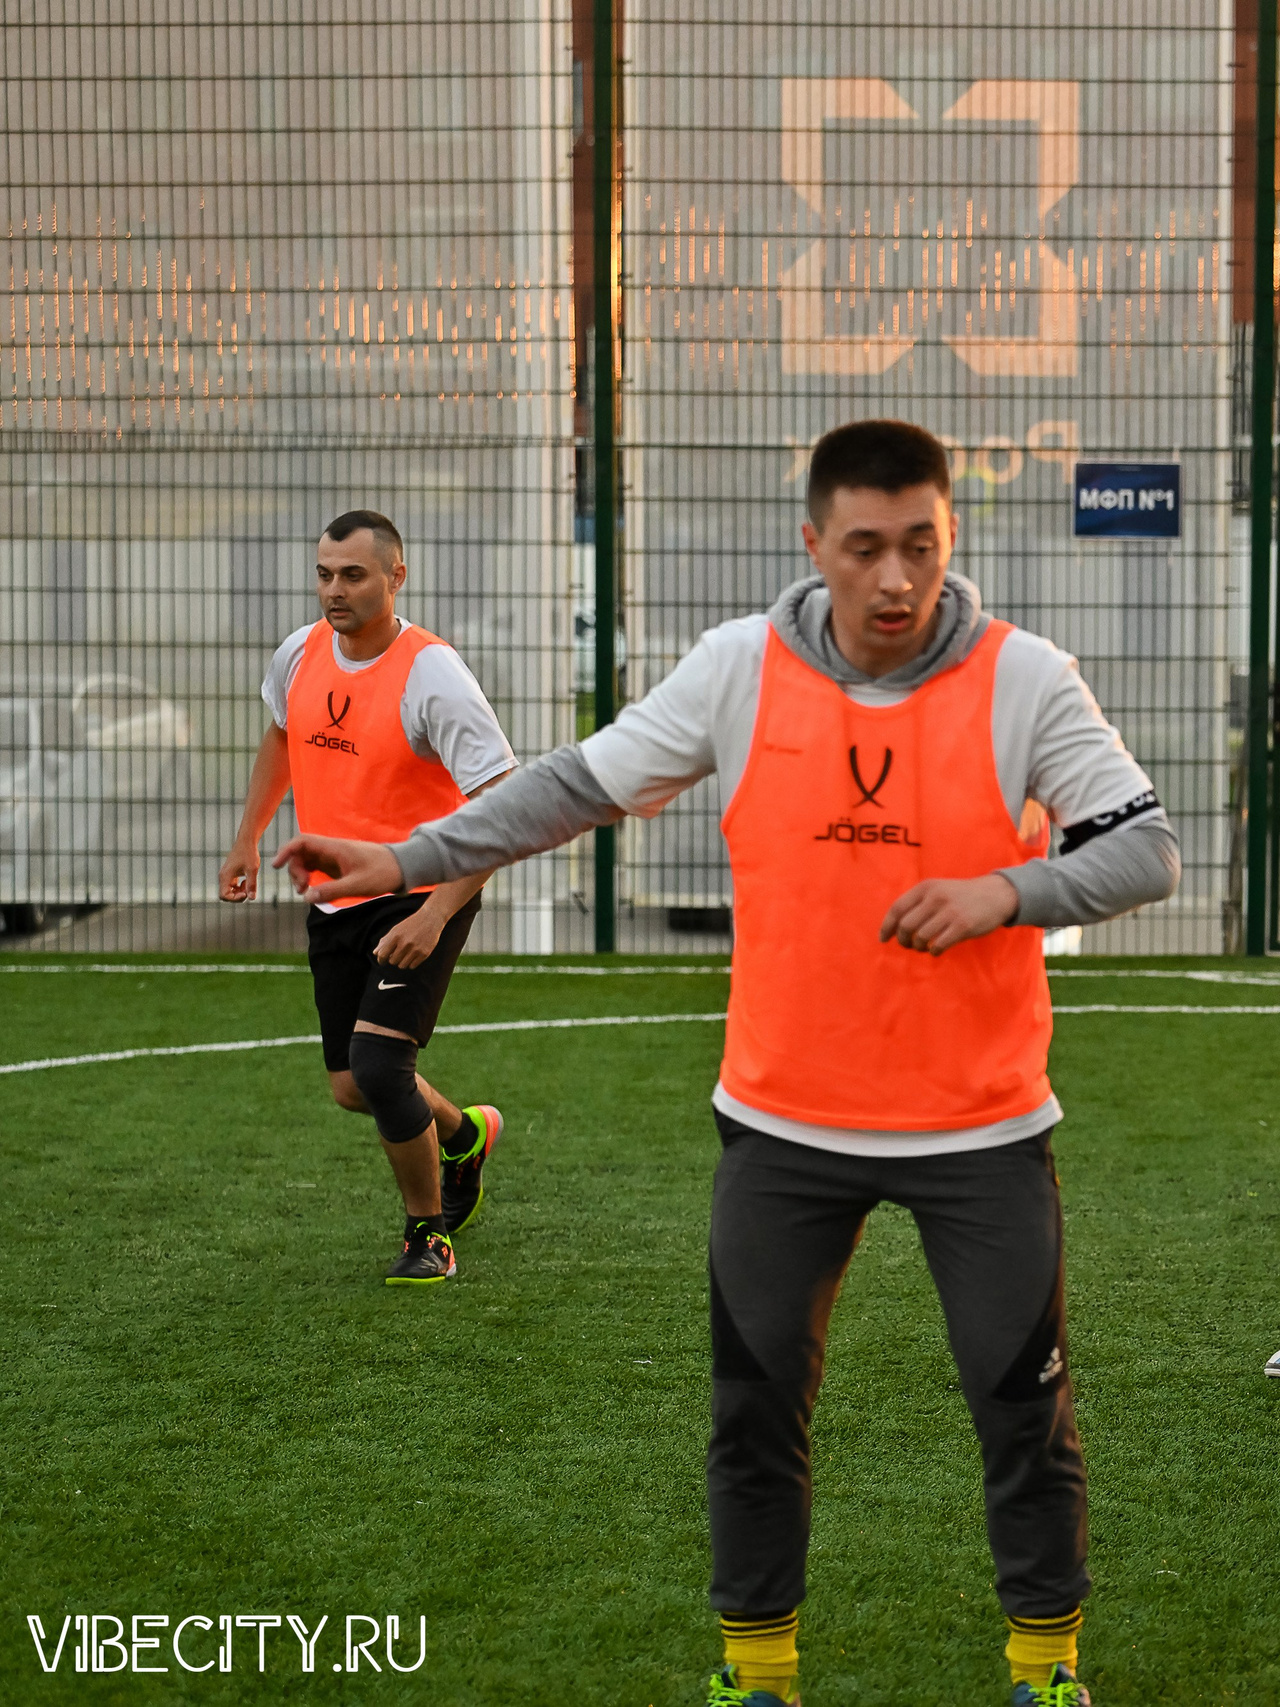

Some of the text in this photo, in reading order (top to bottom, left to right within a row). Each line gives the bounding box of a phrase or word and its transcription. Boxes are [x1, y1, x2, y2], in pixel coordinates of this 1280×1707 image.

[1079, 487, 1135, 511] МФП
[304, 731, 359, 756] JÖGEL
[814, 817, 922, 848] JÖGEL
